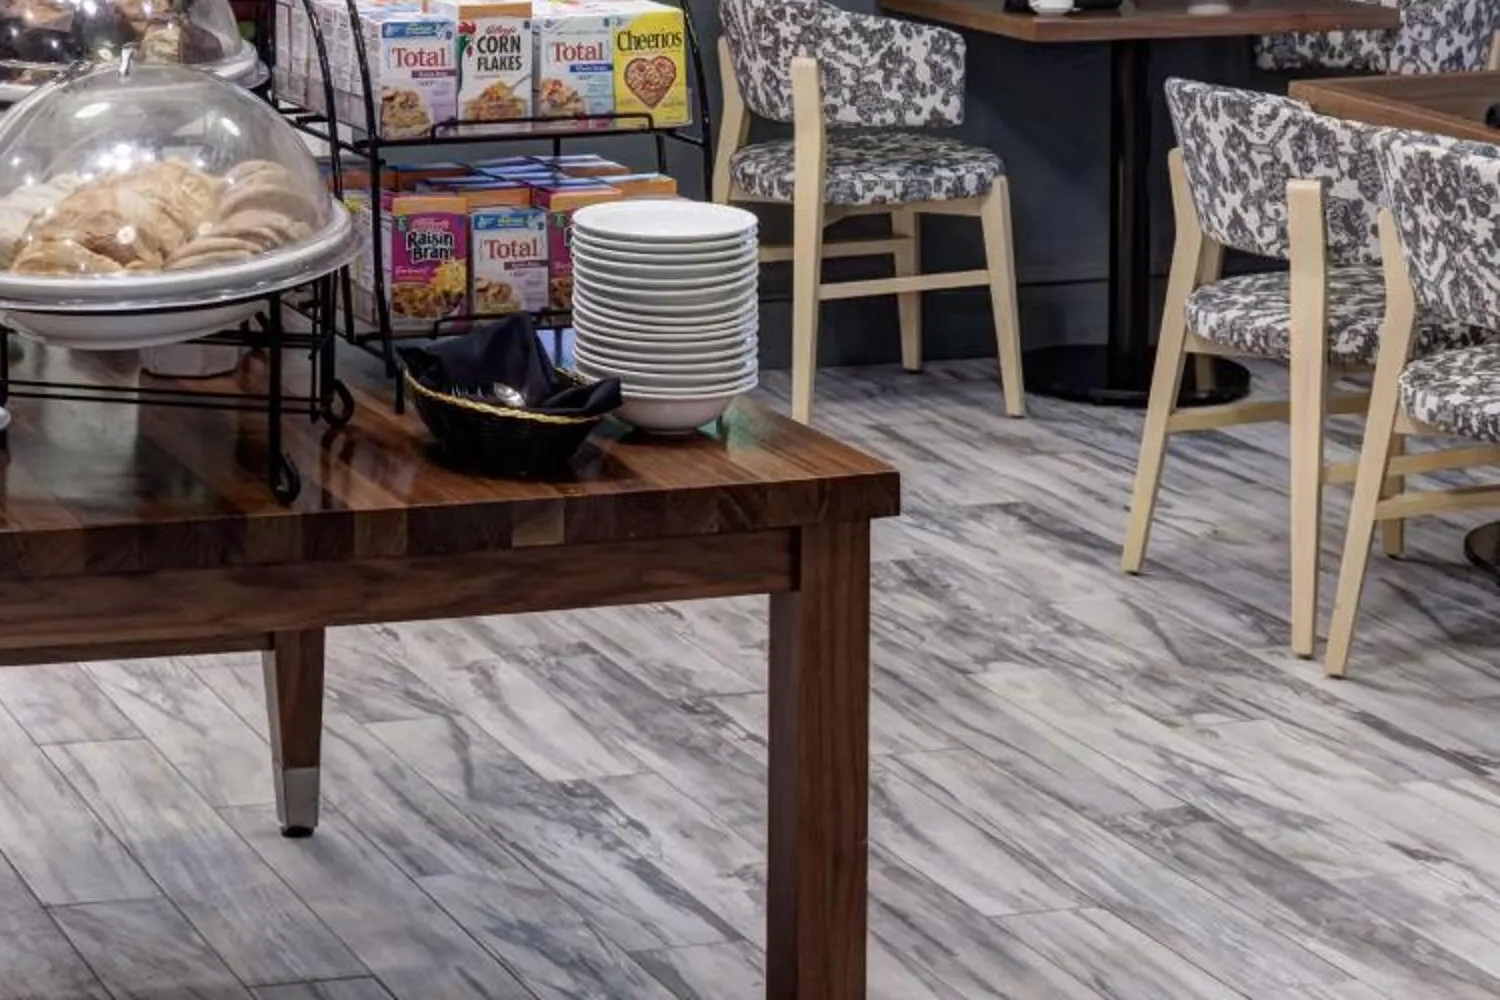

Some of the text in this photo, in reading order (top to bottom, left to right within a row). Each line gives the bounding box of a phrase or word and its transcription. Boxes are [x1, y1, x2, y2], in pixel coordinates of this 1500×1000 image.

[476, 35, 522, 55] CORN
[616, 29, 684, 52] Cheerios
[391, 47, 447, 69] Total
[551, 41, 605, 63] Total
[476, 55, 523, 72] FLAKES
[407, 231, 453, 248] Raisin
[483, 238, 538, 260] Total
[413, 246, 452, 262] Bran
